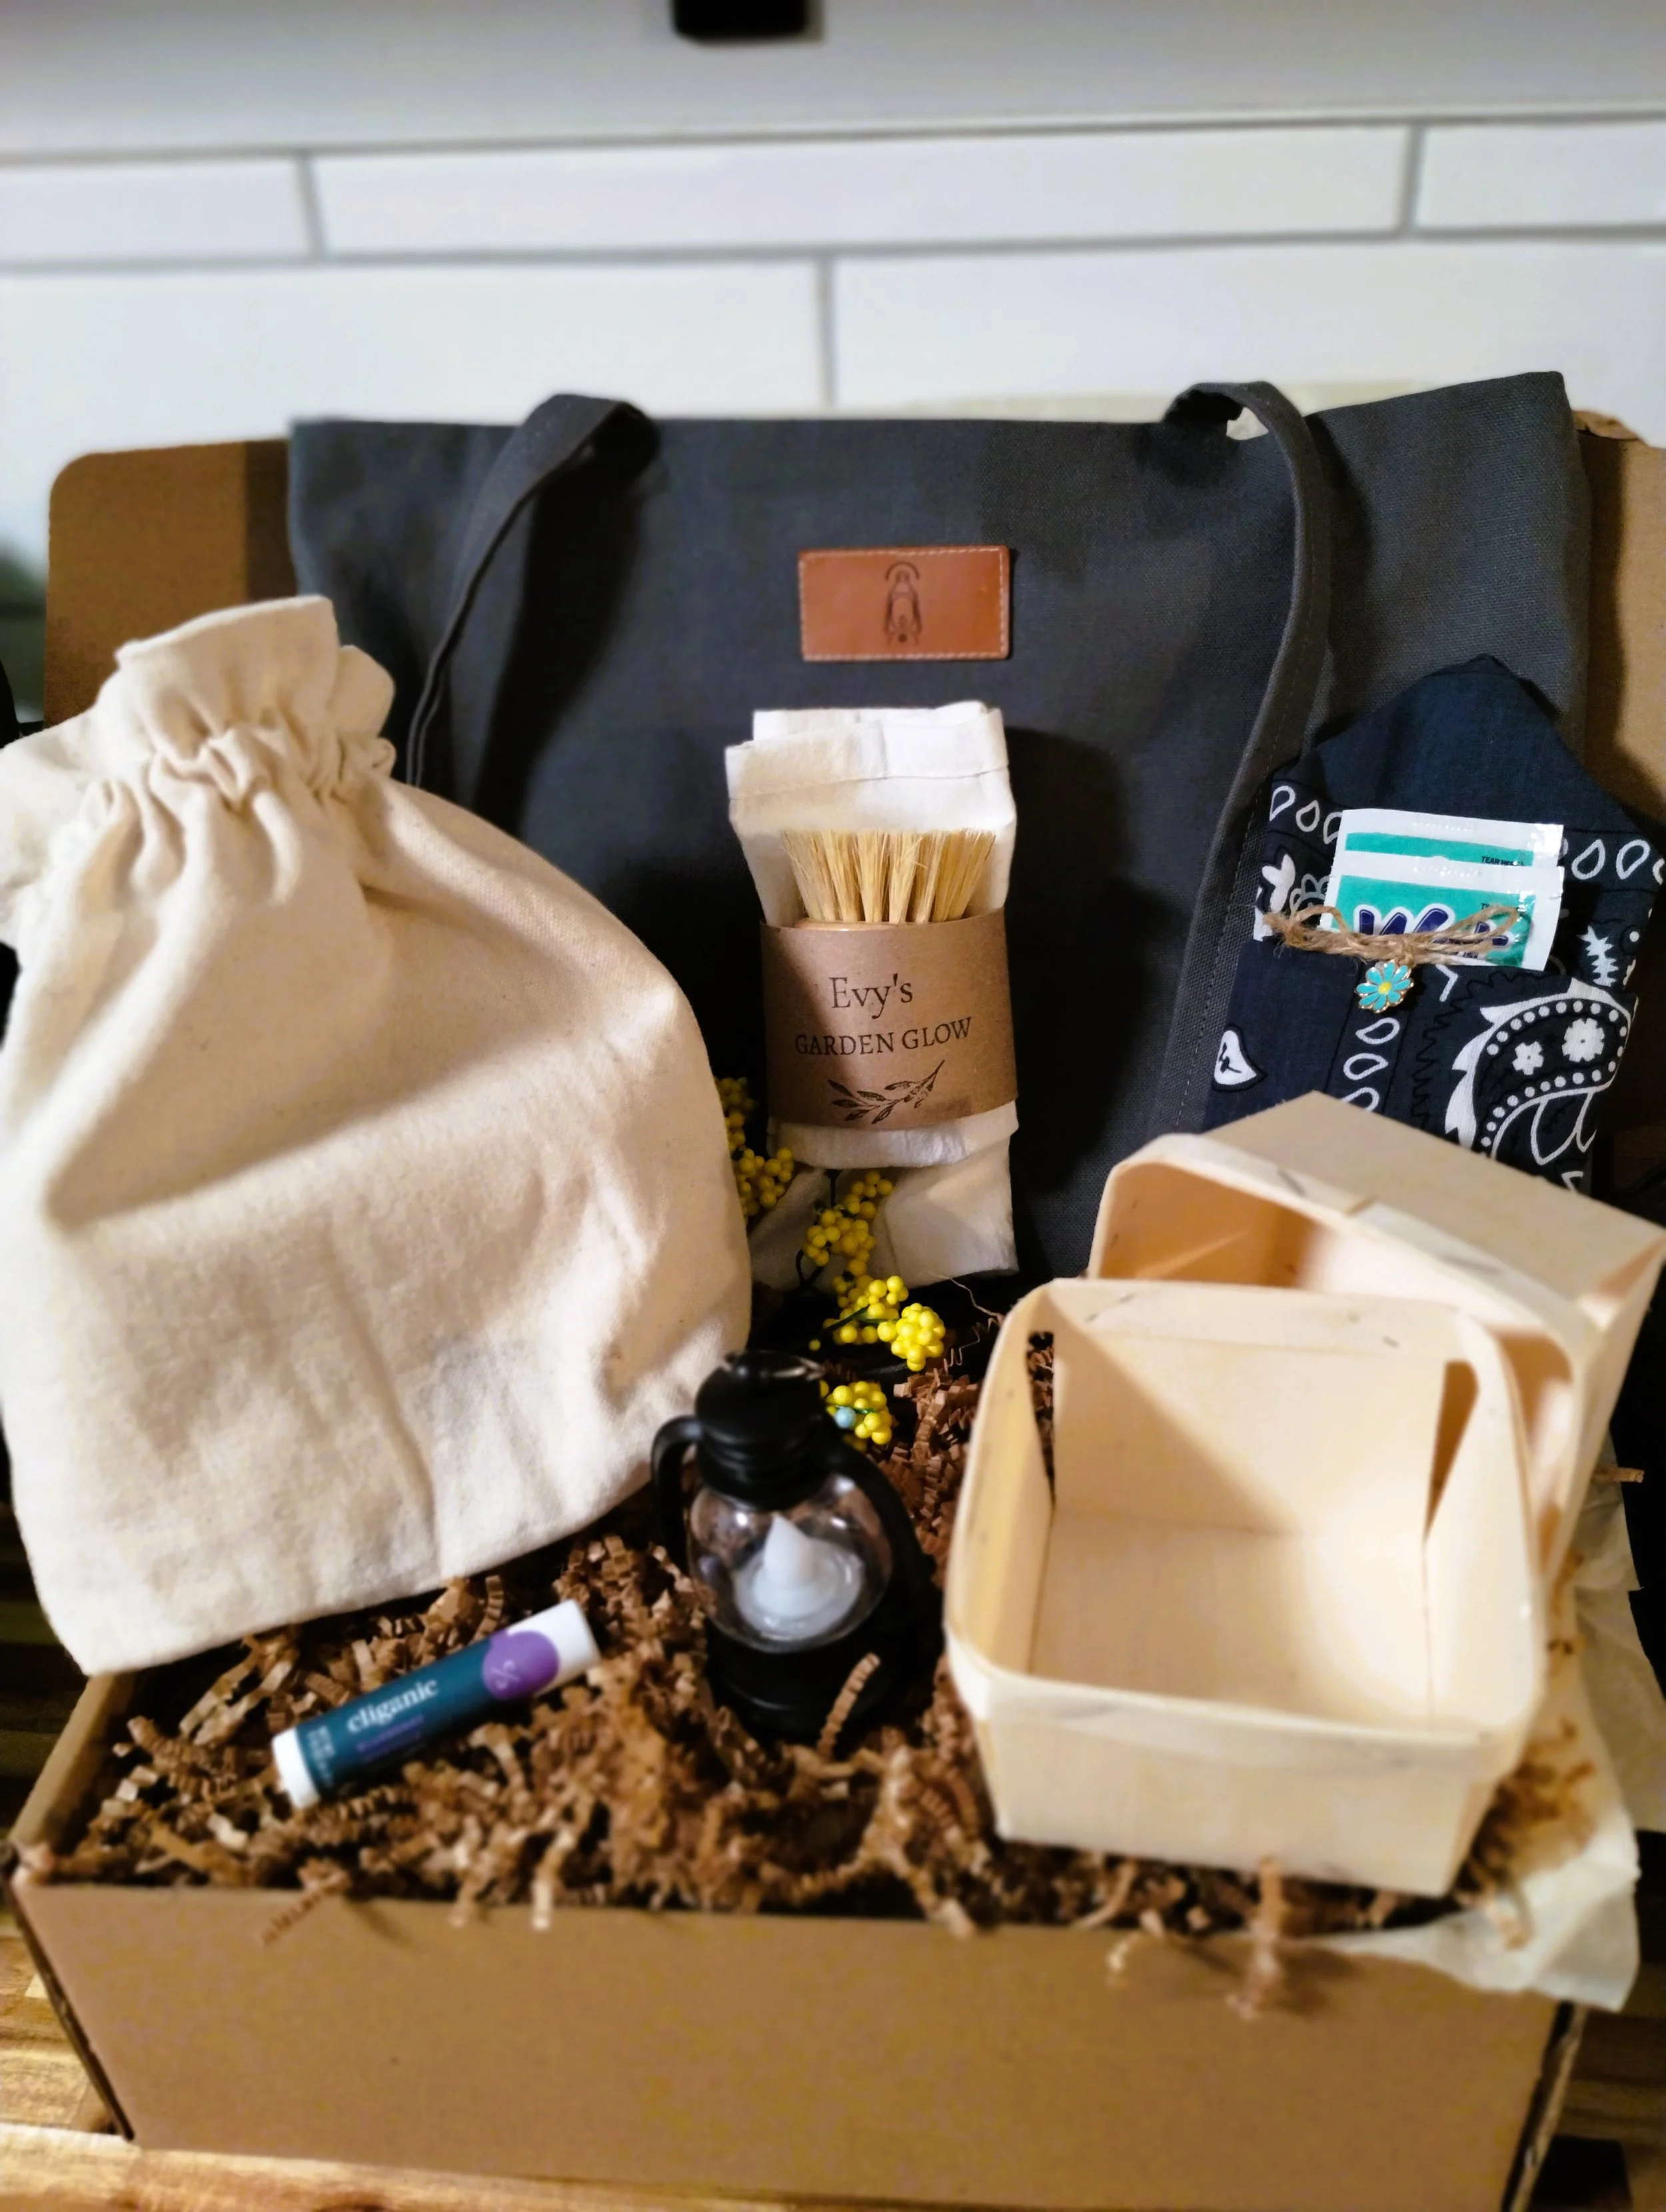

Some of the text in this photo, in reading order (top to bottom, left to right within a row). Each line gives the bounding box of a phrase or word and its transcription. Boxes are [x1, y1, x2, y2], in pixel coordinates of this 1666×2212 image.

[1481, 855, 1499, 865] TEAR
[828, 973, 914, 1019] Evy's
[795, 1017, 972, 1056] GARDEN GLOW
[346, 1679, 438, 1733] cliganic
